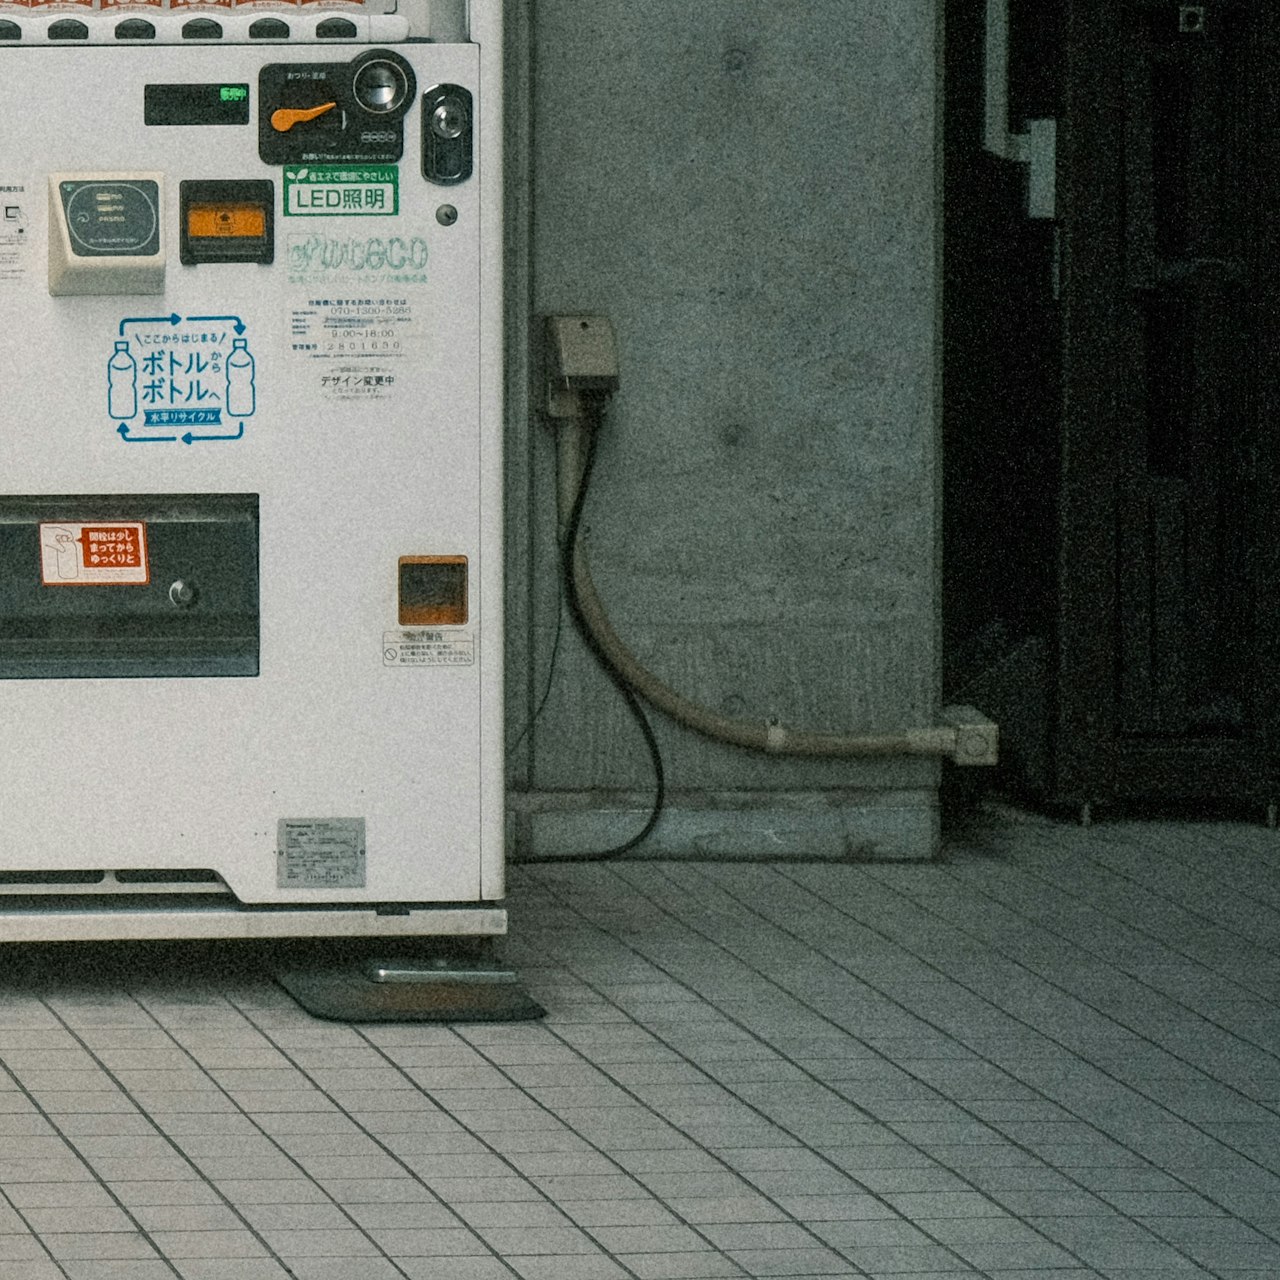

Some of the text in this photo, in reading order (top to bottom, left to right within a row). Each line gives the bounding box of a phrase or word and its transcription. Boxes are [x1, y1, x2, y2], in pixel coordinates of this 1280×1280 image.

[296, 189, 386, 209] LED照明
[143, 333, 218, 345] ここからはじまる
[142, 351, 223, 375] ボトルから
[321, 375, 395, 387] デザイン変更中
[142, 379, 221, 404] ボトルへ
[149, 411, 216, 424] 水平リサイクル
[88, 531, 134, 543] 開栓は少し
[89, 543, 135, 554] まってから
[89, 554, 136, 565] ゆっくりと
